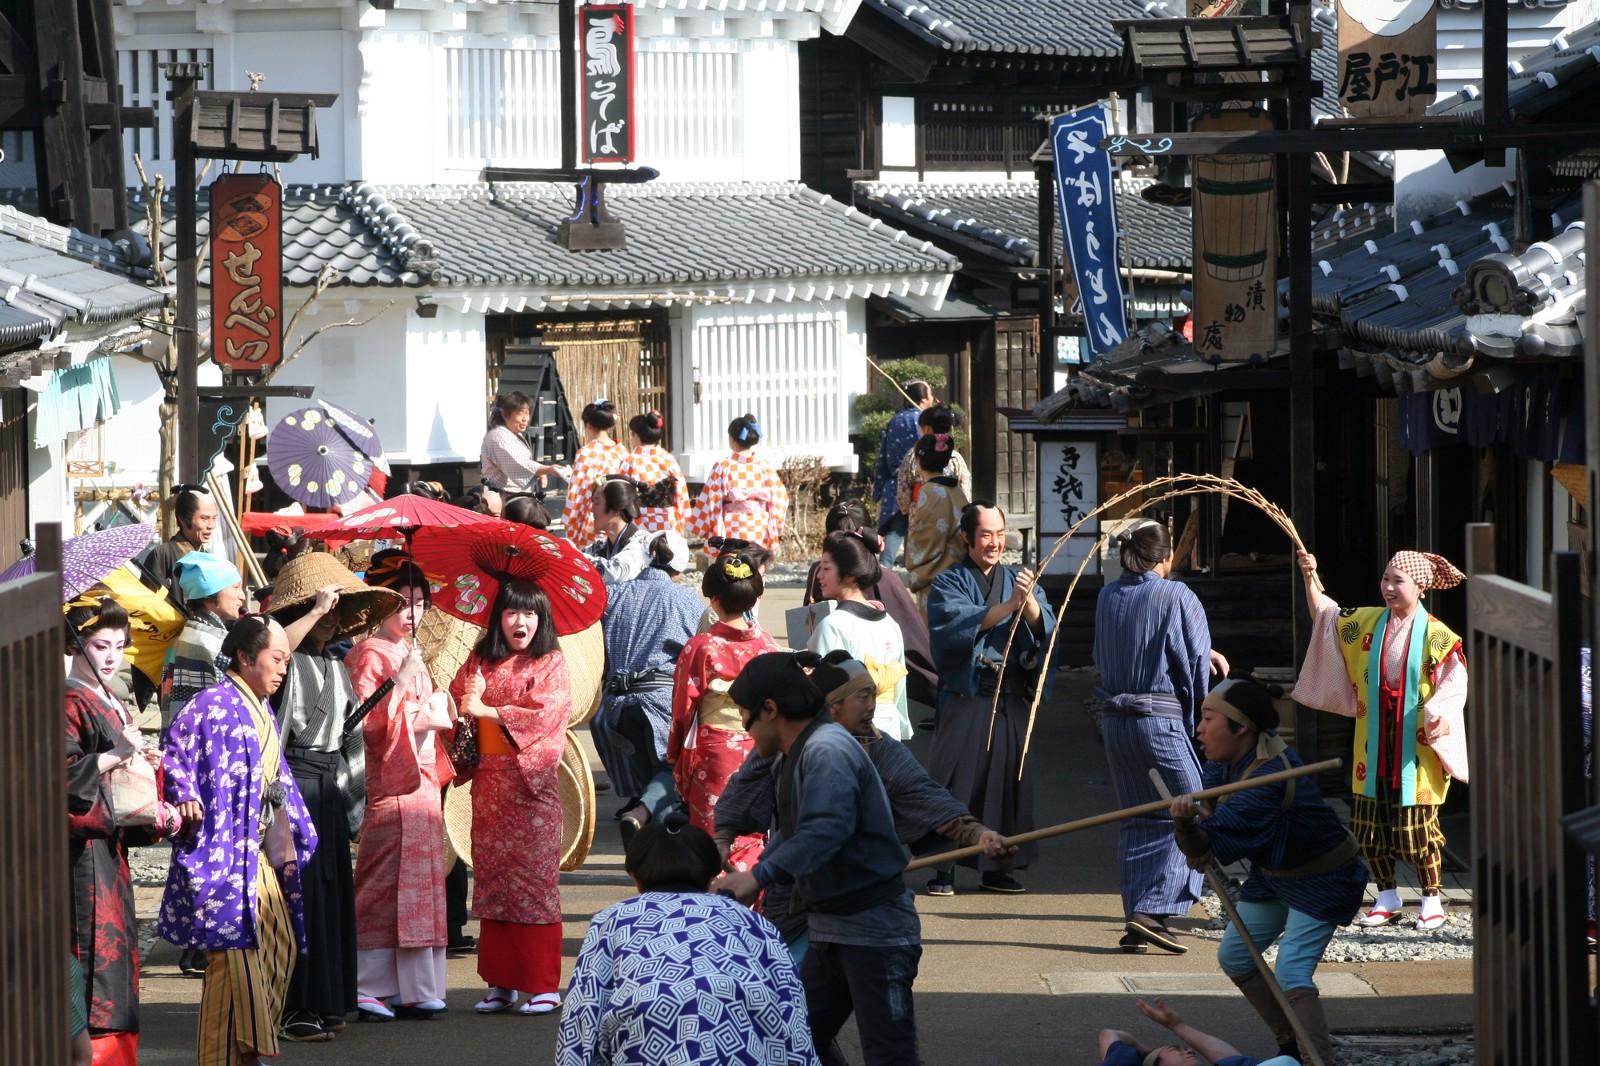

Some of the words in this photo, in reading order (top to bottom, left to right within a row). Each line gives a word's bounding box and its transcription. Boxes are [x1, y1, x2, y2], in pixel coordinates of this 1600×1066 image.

[1338, 52, 1437, 103] 江戸屋
[222, 241, 276, 362] せんべい
